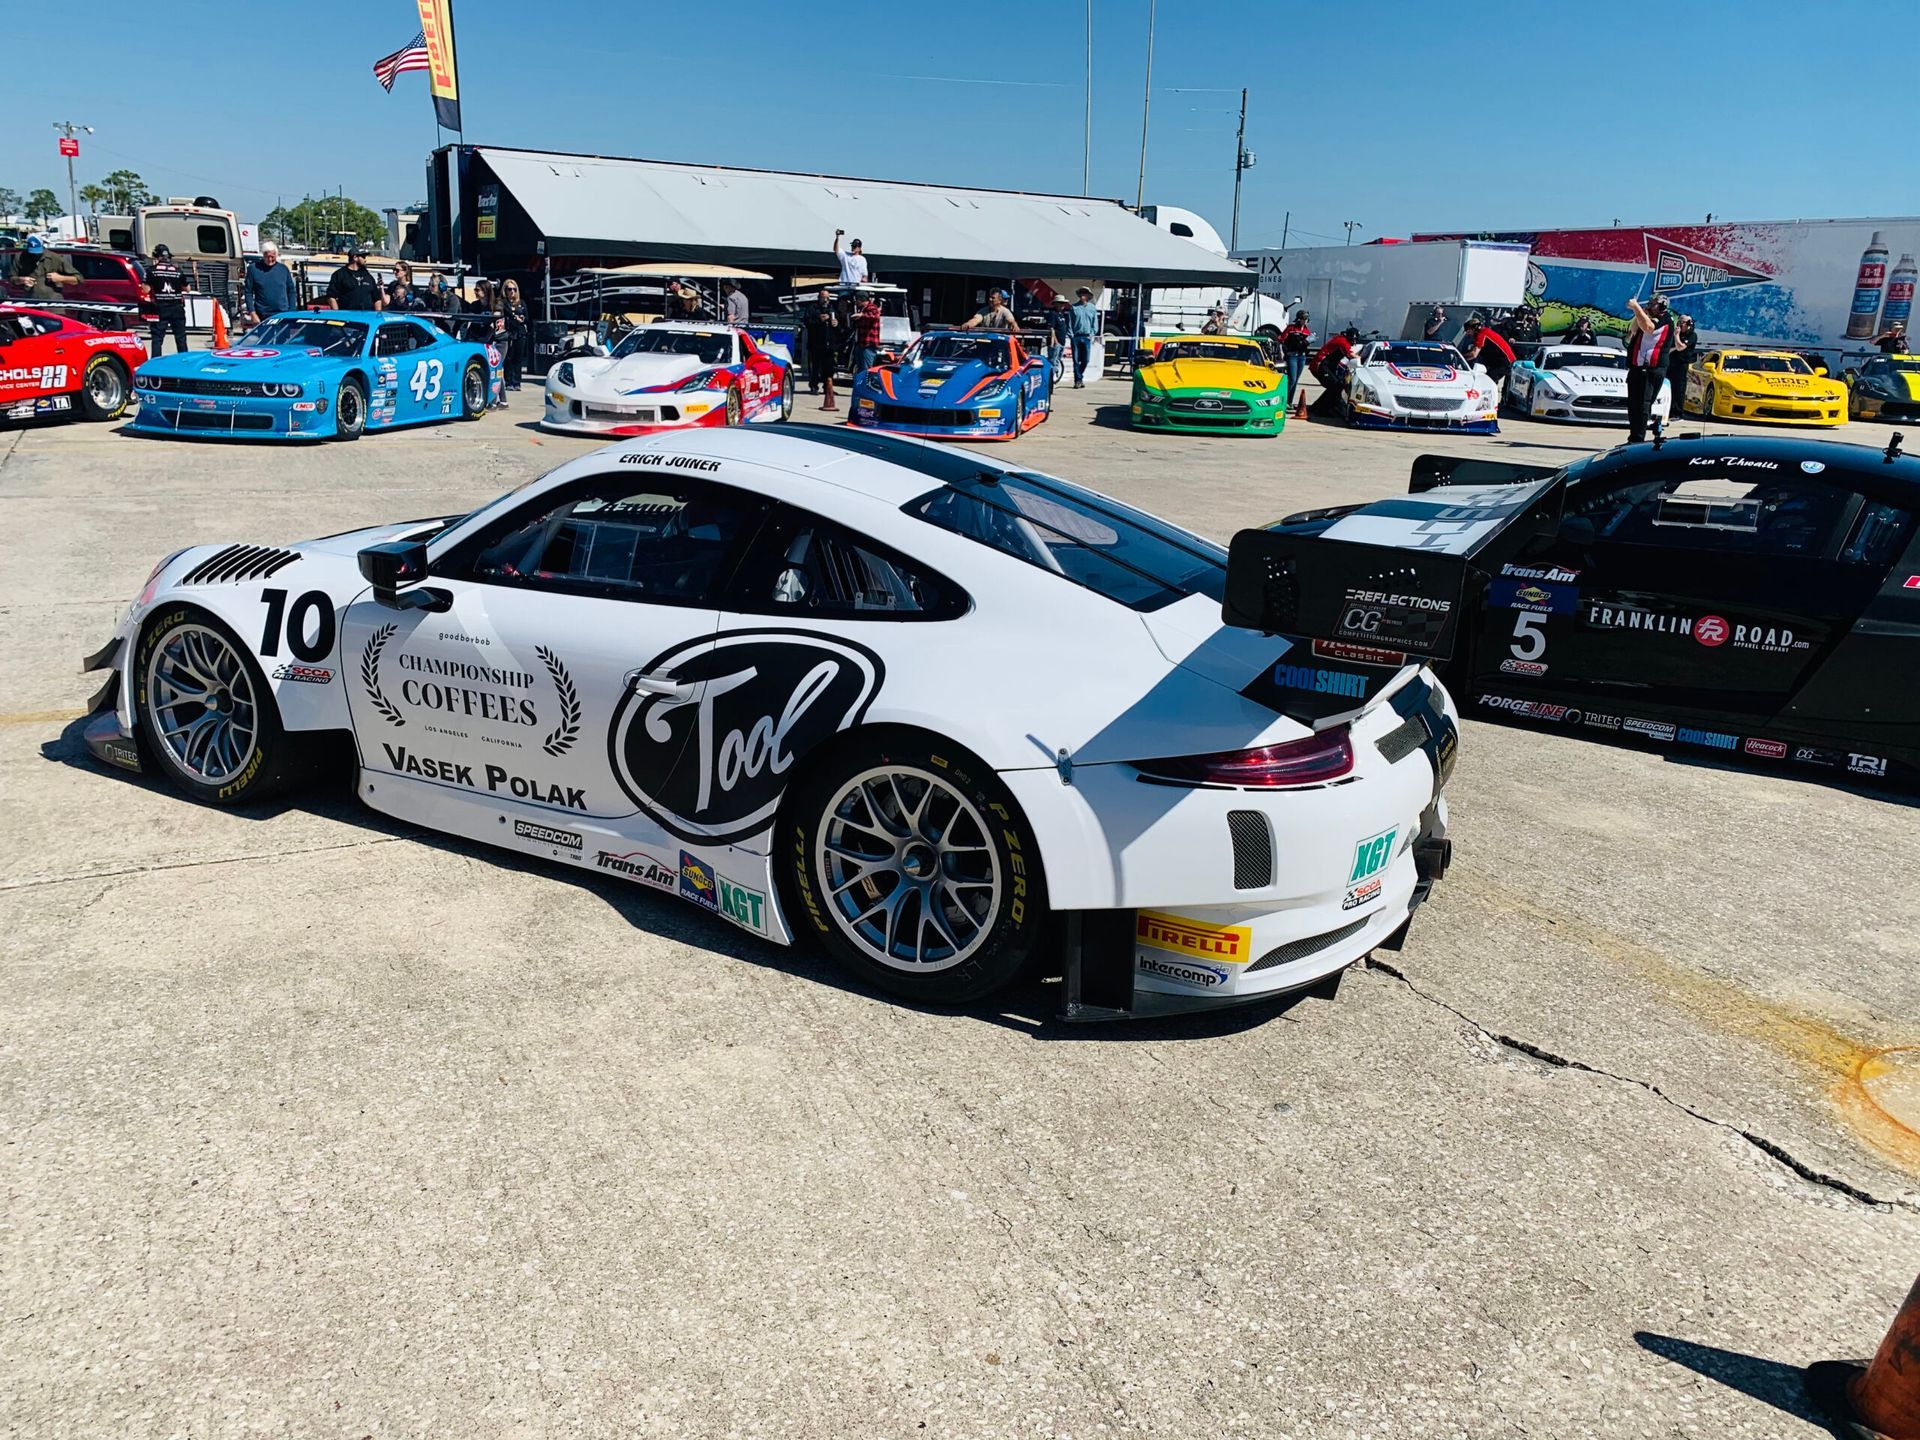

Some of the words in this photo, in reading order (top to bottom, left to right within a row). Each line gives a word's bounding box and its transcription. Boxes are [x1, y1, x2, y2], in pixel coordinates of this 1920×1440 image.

[1654, 251, 1728, 291] Berryman
[1663, 259, 1681, 269] SINCE
[40, 365, 68, 389] 23
[409, 358, 444, 402] 43
[53, 397, 69, 409] TA
[144, 394, 156, 404] 43
[619, 454, 664, 466] ERICH
[665, 457, 722, 472] JOINER
[1689, 457, 1715, 466] Ken
[1501, 563, 1546, 579] Trans
[1544, 568, 1576, 583] Am
[1350, 590, 1451, 612] REFLECTIONS
[1516, 588, 1551, 599] SUNOCO
[1510, 602, 1531, 610] RACE
[1530, 605, 1554, 613] FUELS
[260, 588, 336, 664] 10
[1343, 608, 1382, 631] CG
[1590, 606, 1692, 636] FRANKLIN
[1510, 610, 1548, 661] 5
[291, 666, 331, 677] SCCA
[399, 653, 535, 689] CHAMPIONSHIP
[1516, 661, 1543, 672] SCCA
[273, 672, 292, 681] PRO
[293, 675, 330, 684] RACING
[402, 680, 538, 727] COFFEES
[1478, 694, 1568, 718] FORGELINE
[1584, 711, 1622, 726] TRITEC
[1625, 719, 1675, 733] SPEEDCOM
[425, 725, 438, 733] LOS
[439, 728, 469, 738] ANGELES
[481, 736, 523, 748] CALIFORNIA
[645, 660, 840, 814] Tool
[1747, 740, 1785, 753] Heacock
[113, 747, 138, 762] TRITEC
[1796, 748, 1813, 759] CG
[1848, 753, 1888, 771] TRI
[218, 747, 263, 799] PIRELLI
[1847, 765, 1886, 777] WORKS
[516, 823, 580, 847] SPEEDCOM
[989, 803, 1009, 821] P
[1003, 830, 1028, 924] ZERO
[1351, 830, 1397, 882] XGT
[597, 850, 645, 876] Trans
[644, 864, 675, 887] Am
[683, 867, 713, 889] SUNOCO
[794, 826, 829, 933] PIRELLI
[1355, 878, 1381, 896] SCCA
[681, 888, 700, 900] RACE
[699, 896, 719, 911] FUELS
[718, 879, 764, 929] XGT
[1343, 900, 1358, 910] PRO
[1138, 915, 1240, 955] PIRELLI
[1140, 956, 1217, 987] Intercomp
